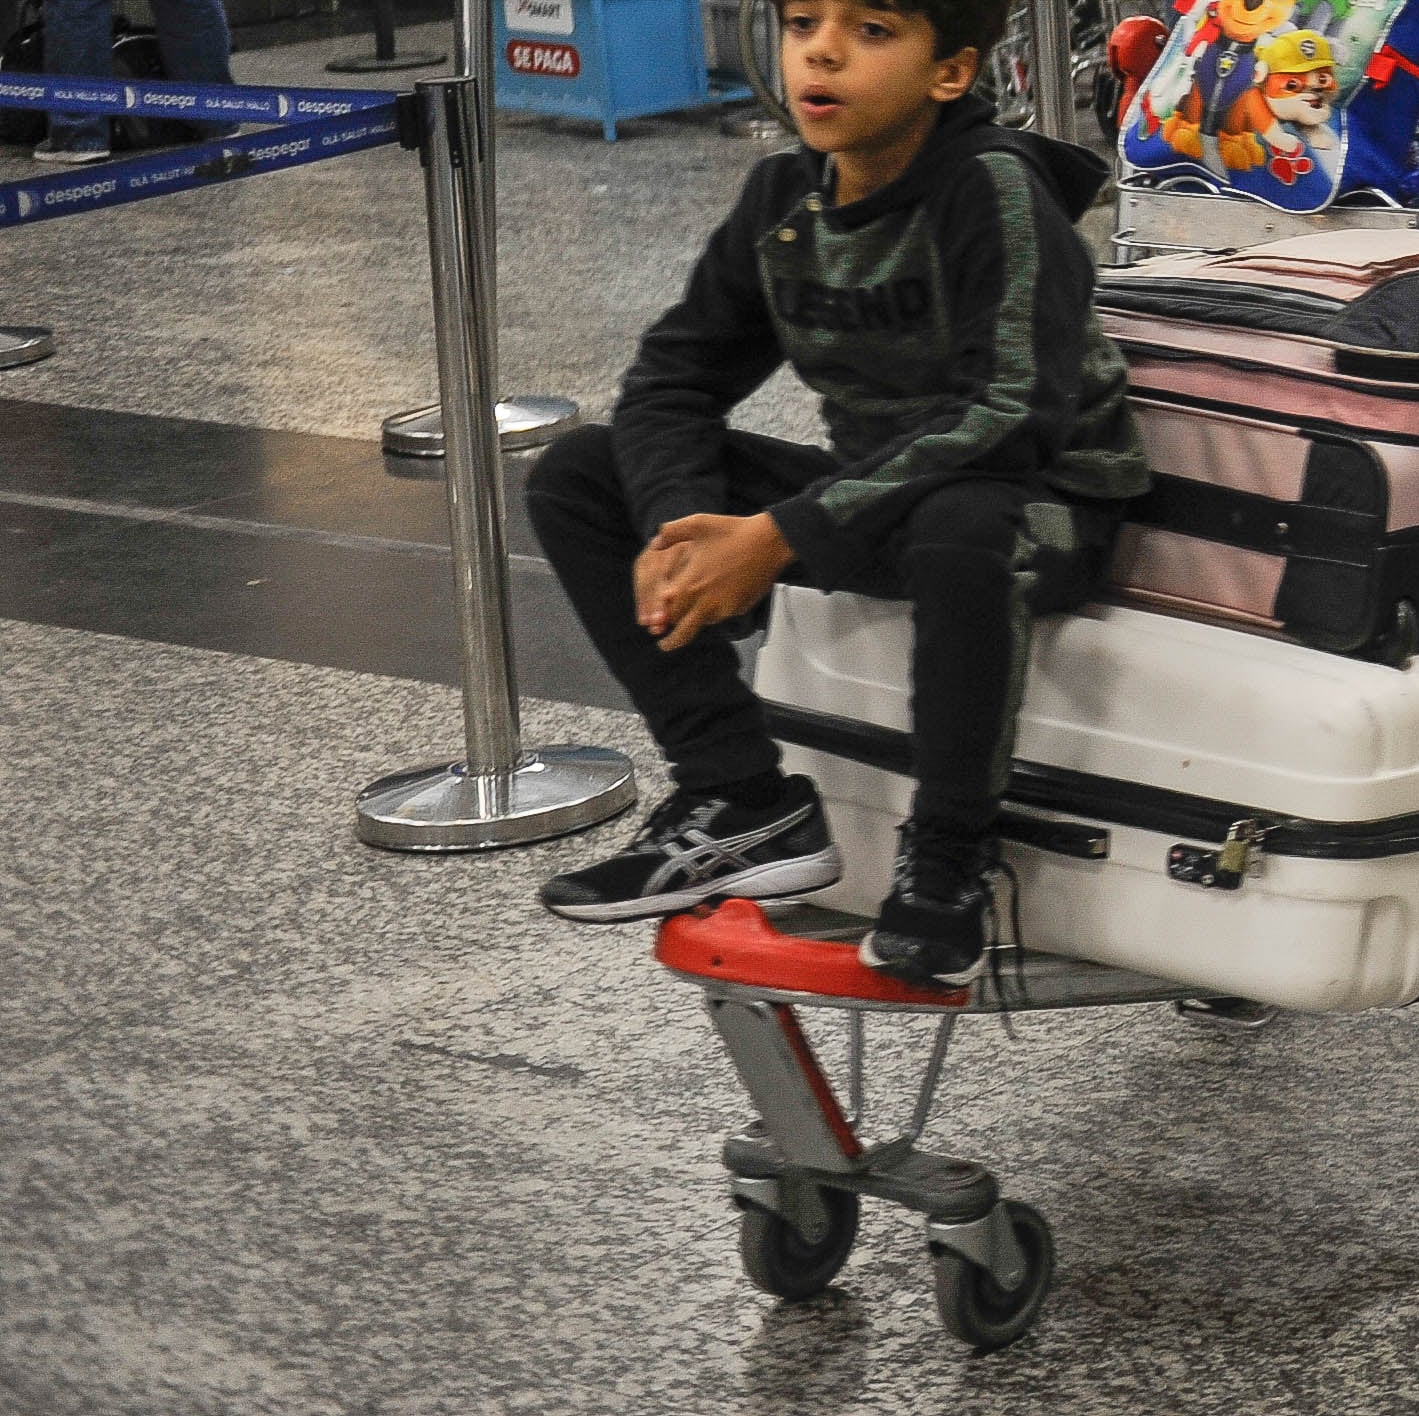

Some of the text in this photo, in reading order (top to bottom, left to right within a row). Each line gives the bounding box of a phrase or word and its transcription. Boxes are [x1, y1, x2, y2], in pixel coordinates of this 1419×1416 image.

[512, 46, 572, 73] SE PAGA
[143, 92, 196, 109] despegar
[297, 100, 353, 116] despegar
[247, 137, 312, 162] despegar
[44, 178, 118, 205] despegar
